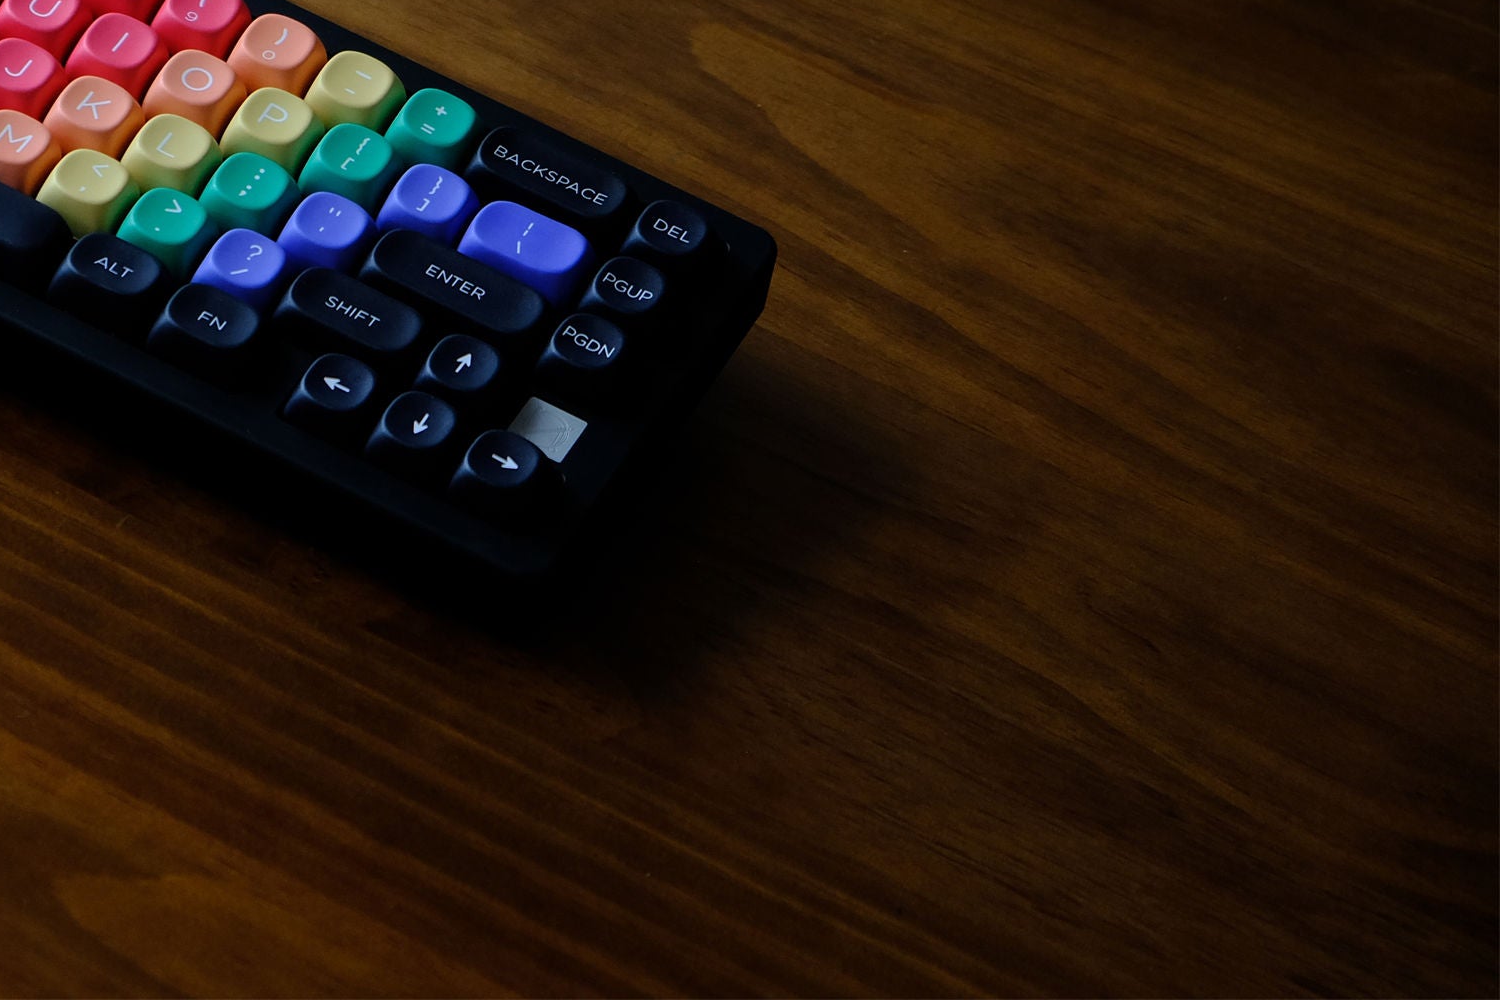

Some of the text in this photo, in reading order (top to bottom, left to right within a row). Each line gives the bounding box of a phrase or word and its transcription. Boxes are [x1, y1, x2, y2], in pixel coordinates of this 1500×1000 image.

[184, 11, 199, 22] 9
[4, 59, 33, 77] J
[181, 67, 213, 92] O
[75, 90, 112, 120] K
[257, 102, 289, 124] P
[435, 106, 448, 116] +
[420, 123, 436, 135] =
[155, 132, 176, 159] L
[493, 145, 608, 206] BACKSPACE
[653, 218, 690, 244] DEL
[246, 244, 263, 261] ?
[93, 257, 134, 278] ALT
[425, 264, 486, 301] ENTER
[602, 272, 654, 301] PGUP
[197, 310, 227, 331] FN
[325, 296, 381, 327] SHIFT
[562, 325, 616, 358] PGDN
